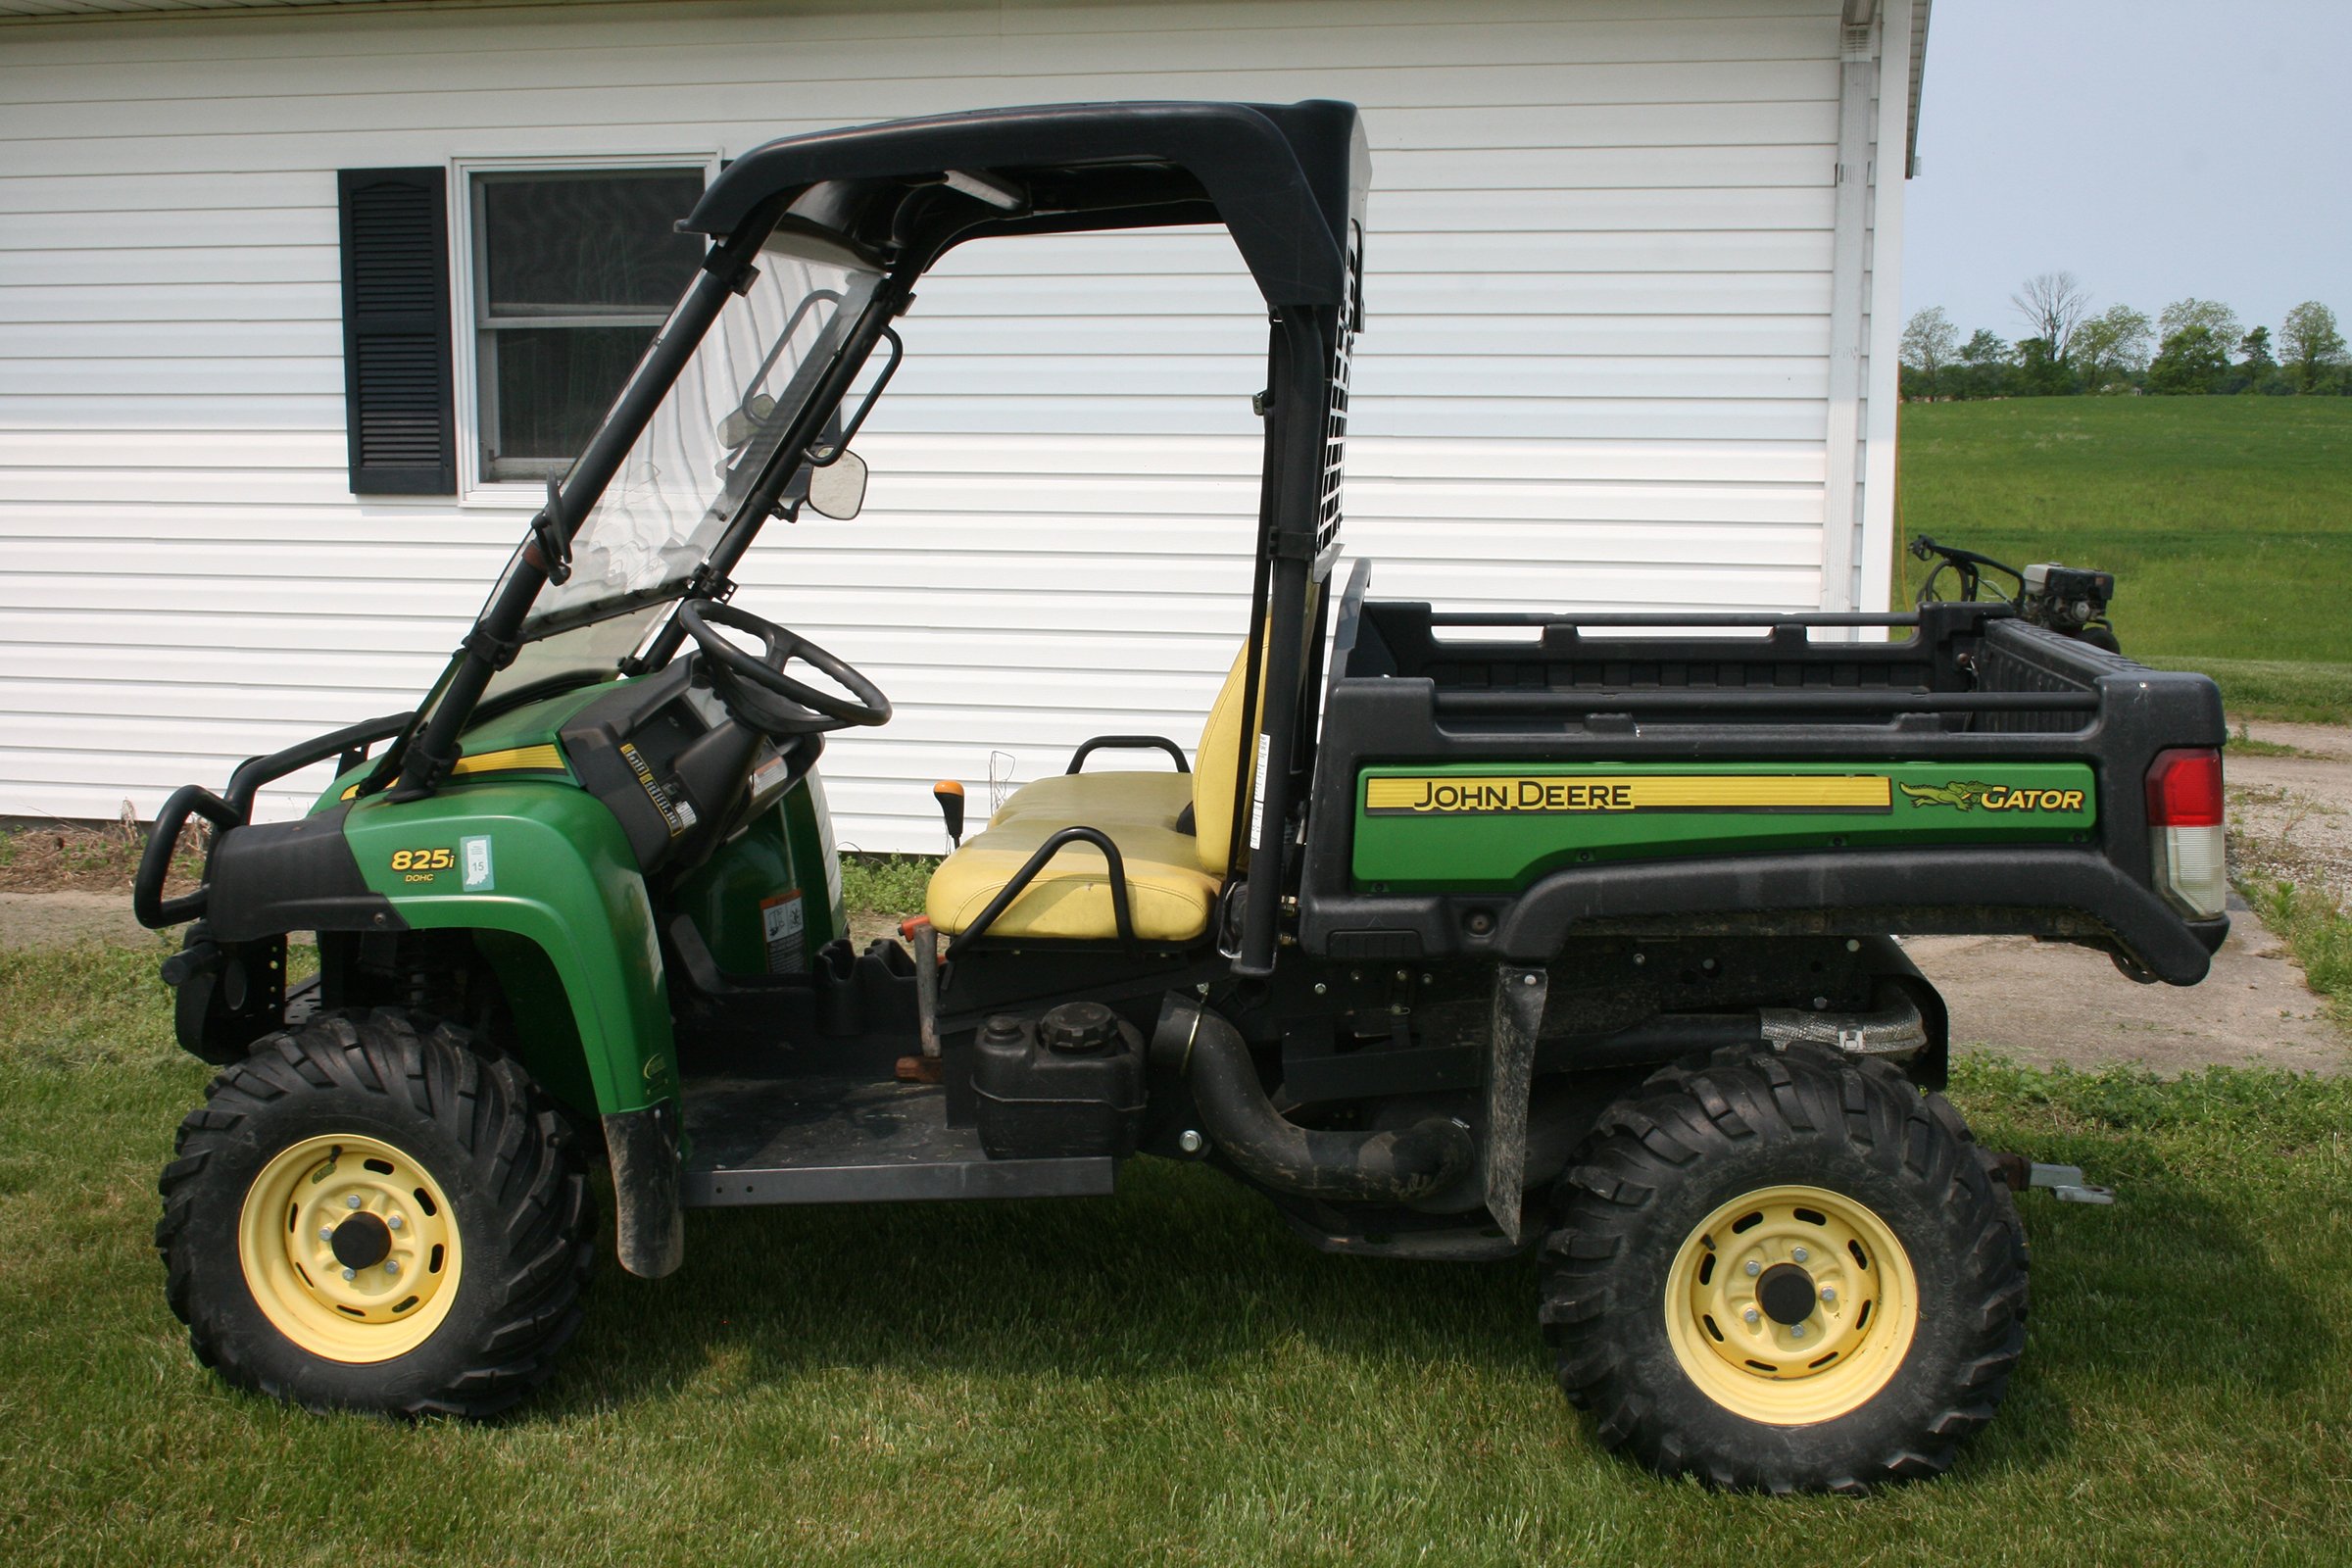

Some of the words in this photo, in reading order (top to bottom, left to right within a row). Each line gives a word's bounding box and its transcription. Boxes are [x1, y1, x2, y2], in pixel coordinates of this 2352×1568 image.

[1413, 780, 1510, 809] JOHN
[1517, 780, 1633, 809] DEERE
[1980, 785, 2084, 810] GATOR
[391, 848, 456, 871] 825i
[471, 861, 485, 872] 15
[405, 873, 434, 883] DOHC
